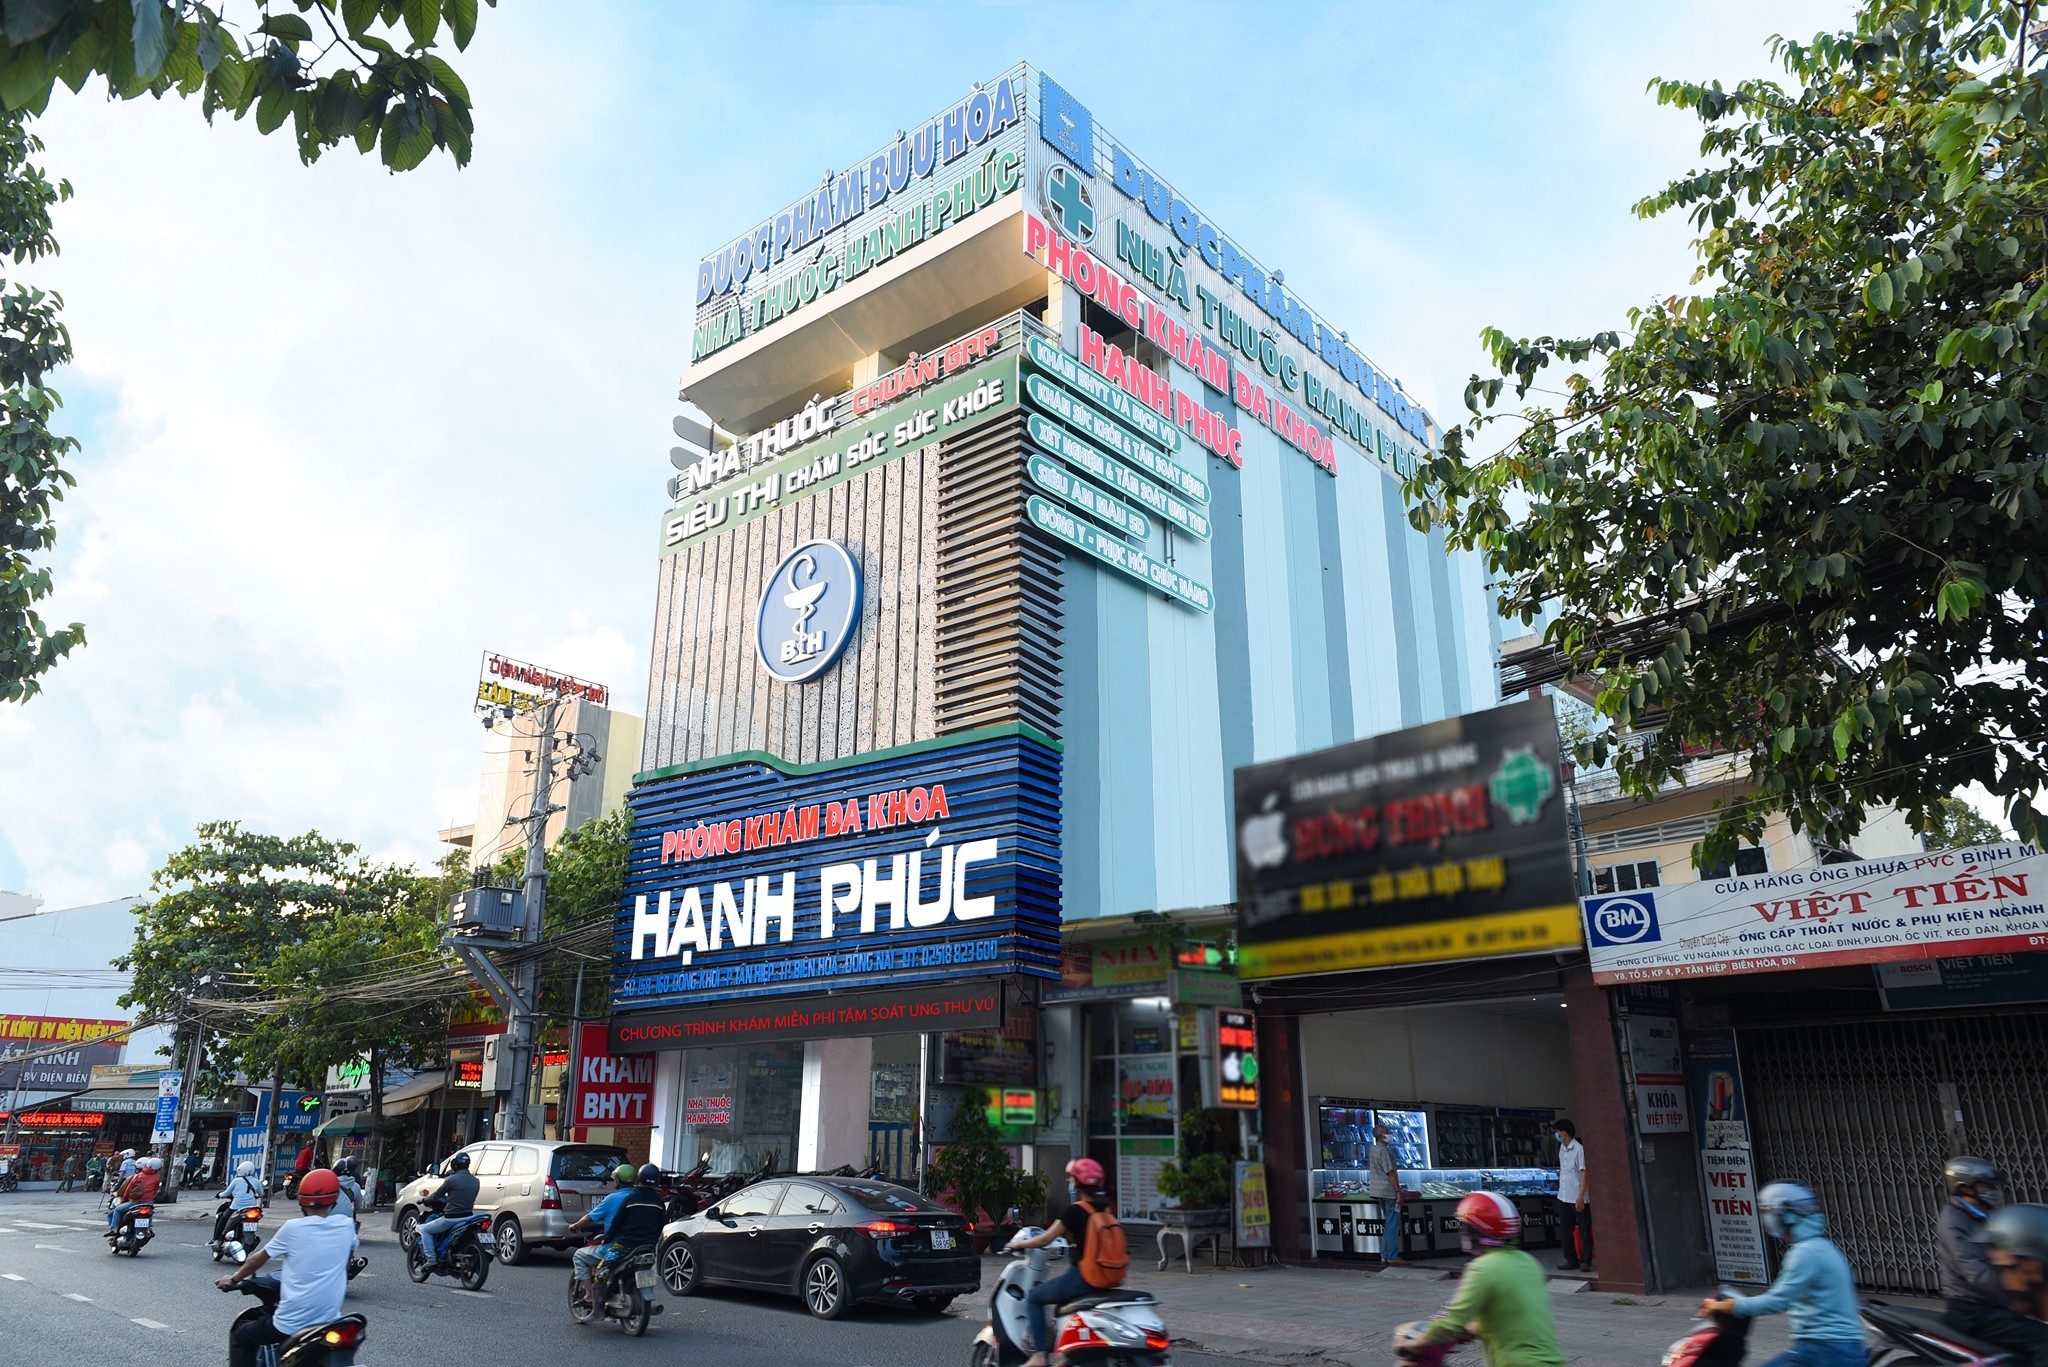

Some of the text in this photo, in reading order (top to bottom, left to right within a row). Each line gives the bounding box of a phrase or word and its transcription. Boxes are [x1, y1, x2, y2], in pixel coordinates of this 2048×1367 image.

[696, 75, 1018, 307] DƯỢC PHẨM BỬU HÒA
[1112, 144, 1219, 270] DƯỢC
[691, 149, 1018, 363] NHÀ THUỐC PHÚC
[1024, 211, 1339, 477] PHÒNG KHÁM ĐA KHOA
[1117, 218, 1374, 453] NHÀ HẠNH
[747, 327, 998, 465] THUỐC CHUẨN GPP
[1078, 367, 1176, 449] BHYT VÀ DỊCH VỤ
[1173, 388, 1243, 470] PHÚC
[665, 378, 1004, 547] SIÊU THỊ CHĂM SÓC SỨC KHỎE
[1039, 421, 1187, 524] XÉT & SOÁT UNG
[1123, 435, 1131, 454] &
[1155, 455, 1181, 484] SOÁT
[1037, 463, 1145, 536] SIÊU 5D
[1076, 523, 1178, 591] Y PHỤC CHỨC
[479, 680, 512, 706] LÂM
[661, 783, 950, 865] PHÒNG KHÁM ĐA KHOA
[1714, 847, 2012, 894] CỬA HÀNG NHỰA PVC BÌNH
[630, 826, 998, 966] HẠNH PHÚC
[1750, 865, 2029, 923] VIỆT TIẾN
[1606, 907, 1645, 928] BM
[1679, 903, 2045, 949] Chuyên Cung Cấp: ỐNG CẤP THOÁT NƯỚC & PHỤ KIỆN NGÀNH
[734, 940, 998, 985] TÂN HIỆP BIÊN HÒA ĐỒNG NAI 02518 823 600
[1642, 920, 2040, 966] CỤ PHỤC VỤ NGÀNH XÂY DỰNG, CÁC LOẠI: ỐC VÍT, KEO DÁN, KHÓA
[1614, 956, 1797, 981] Y8, TỔ 5, KP 4, P. TÂN HIỆP BIÊN HÒA, ĐN
[1900, 963, 1932, 974] BOSCH
[39, 1021, 56, 1039] BV
[56, 1018, 84, 1042] ĐIỆN
[620, 995, 995, 1042] CHƯƠNG TRÌNH KHÁM MIỄN PHÍ SOÁT UNG THƯ VÚ
[23, 1070, 88, 1085] BV ĐIỆN BIÊN
[460, 1062, 478, 1072] TIỆM
[466, 1080, 482, 1089] NGỌC
[63, 1116, 83, 1124] 30%
[80, 1101, 106, 1111] TRẠM
[107, 1098, 134, 1110] XĂNG
[293, 1115, 312, 1125] ANH
[583, 1092, 647, 1120] BHYT
[686, 1110, 730, 1126] HẠNH PHÚC
[687, 1094, 731, 1110] NHÀ THUỐC
[1646, 1112, 1683, 1128] VIỆT TIỆP
[1647, 1089, 1678, 1108] KHÓA
[1706, 1155, 1746, 1168] TIỆM ĐIỆN
[1708, 1169, 1747, 1191] VIỆT
[1711, 1195, 1753, 1217] TIẾN
